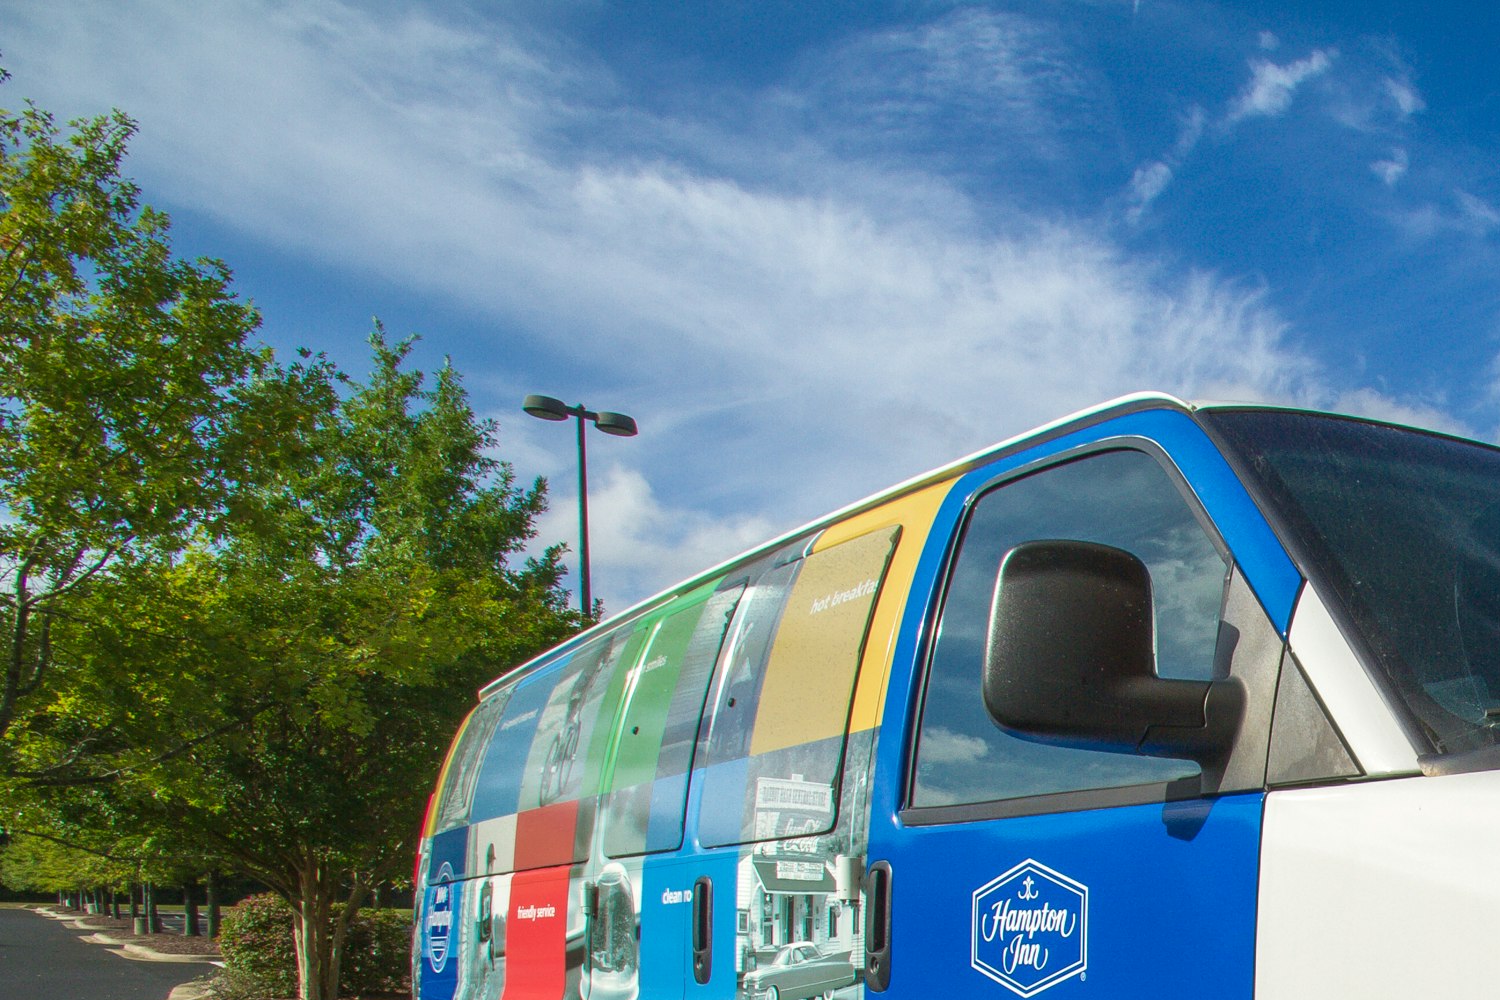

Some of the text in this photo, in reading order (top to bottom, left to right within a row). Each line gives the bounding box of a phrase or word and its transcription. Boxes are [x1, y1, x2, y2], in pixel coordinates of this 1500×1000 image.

[810, 579, 880, 615] hot breakfas
[517, 904, 555, 921] friendly service
[662, 888, 692, 904] clean ro
[982, 898, 1076, 942] Hampton
[1002, 934, 1049, 975] Inn
